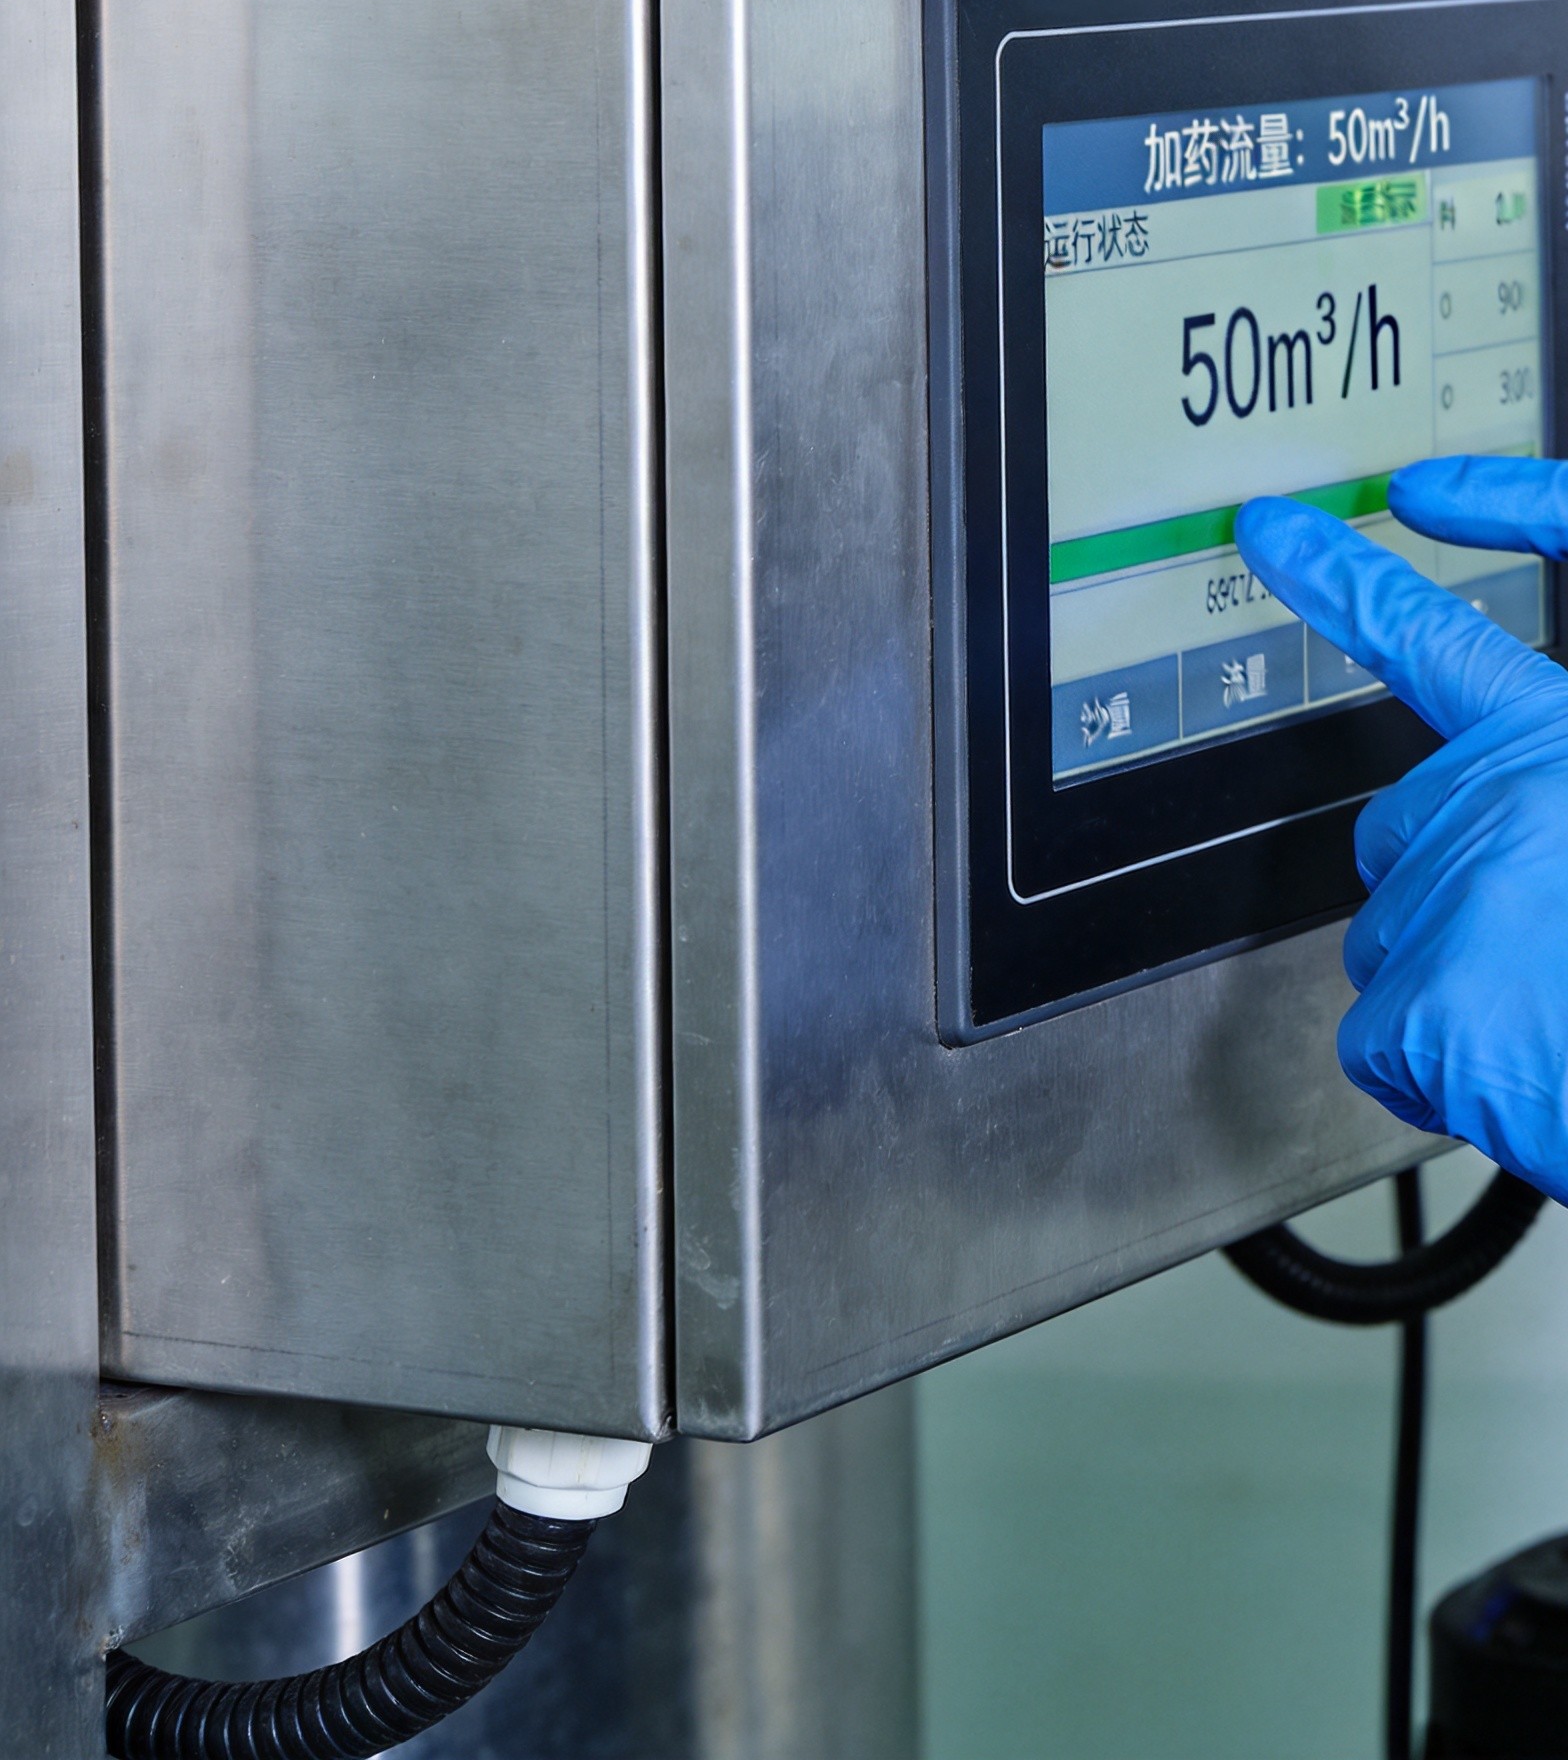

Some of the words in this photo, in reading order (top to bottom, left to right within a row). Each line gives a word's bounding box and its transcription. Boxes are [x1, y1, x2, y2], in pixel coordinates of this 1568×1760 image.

[1044, 210, 1150, 269] 运行状态
[1181, 282, 1401, 428] 50m³/h
